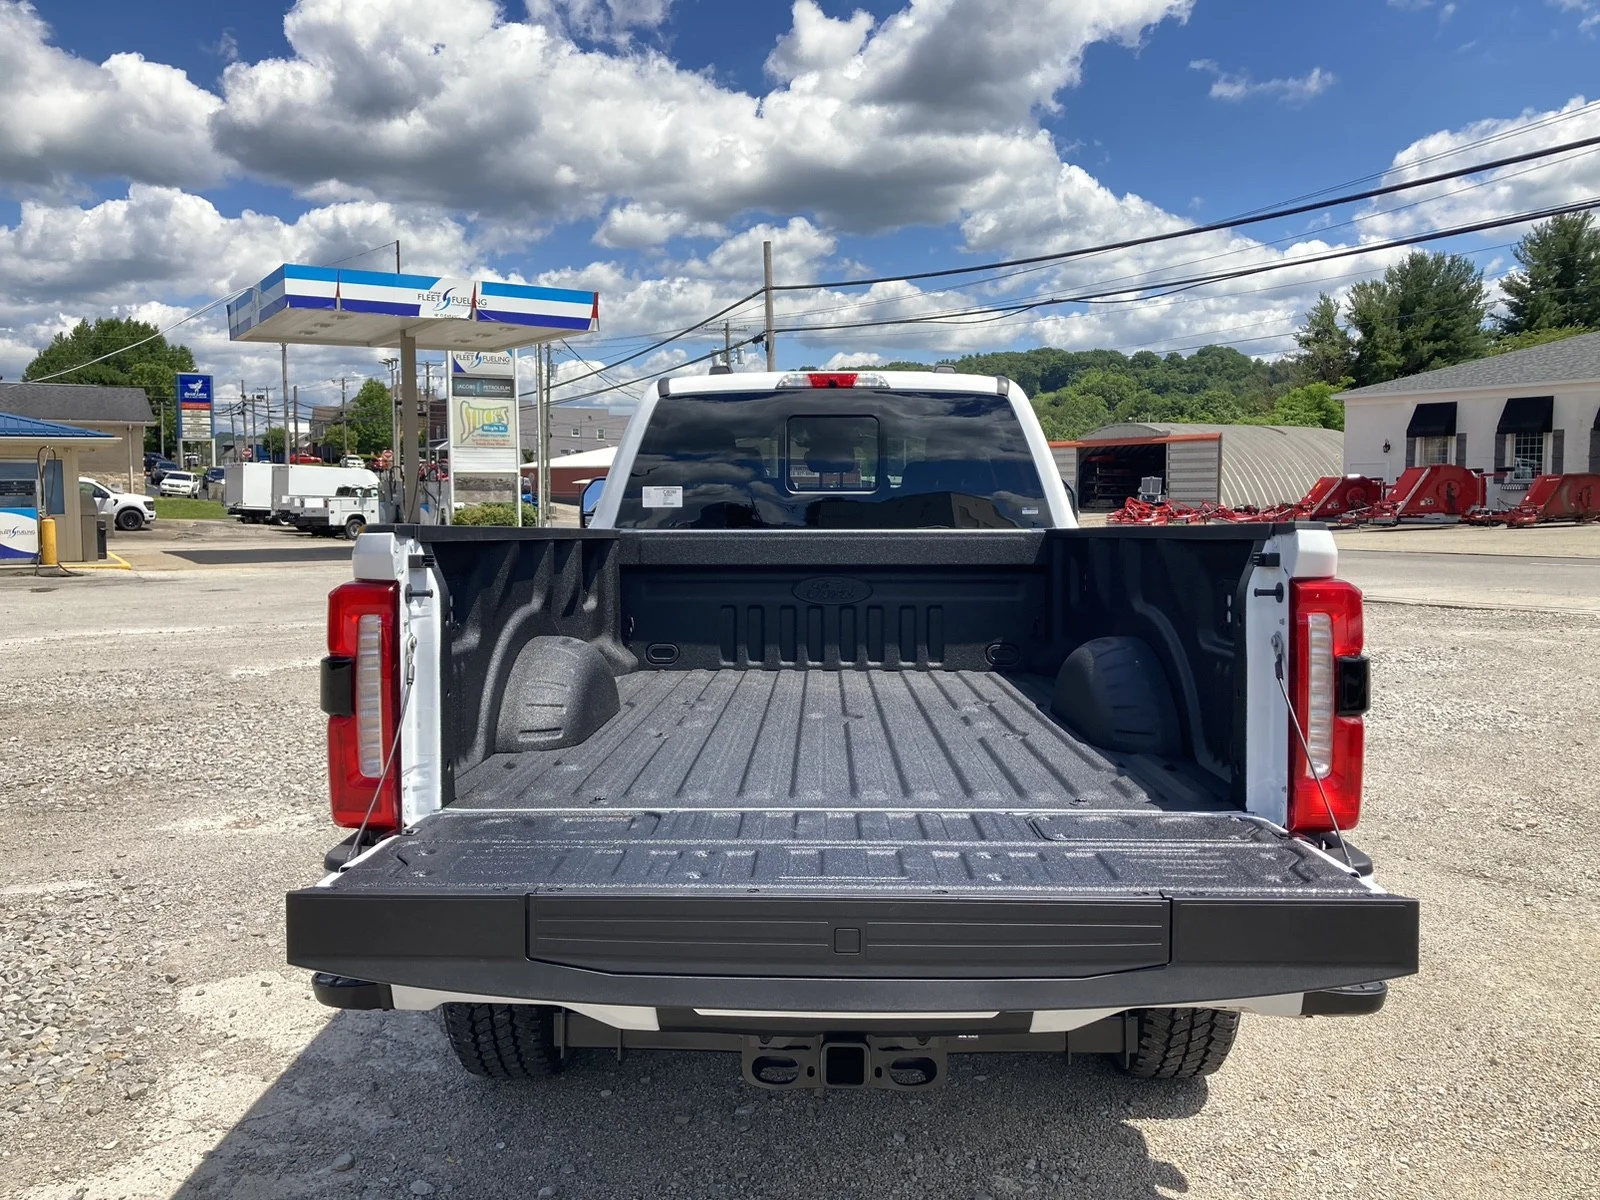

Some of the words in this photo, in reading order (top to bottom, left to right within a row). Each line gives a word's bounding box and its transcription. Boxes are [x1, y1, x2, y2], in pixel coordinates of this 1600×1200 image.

[417, 293, 441, 302] FLEET
[451, 296, 487, 306] FUELNG
[482, 355, 510, 363] FUELING
